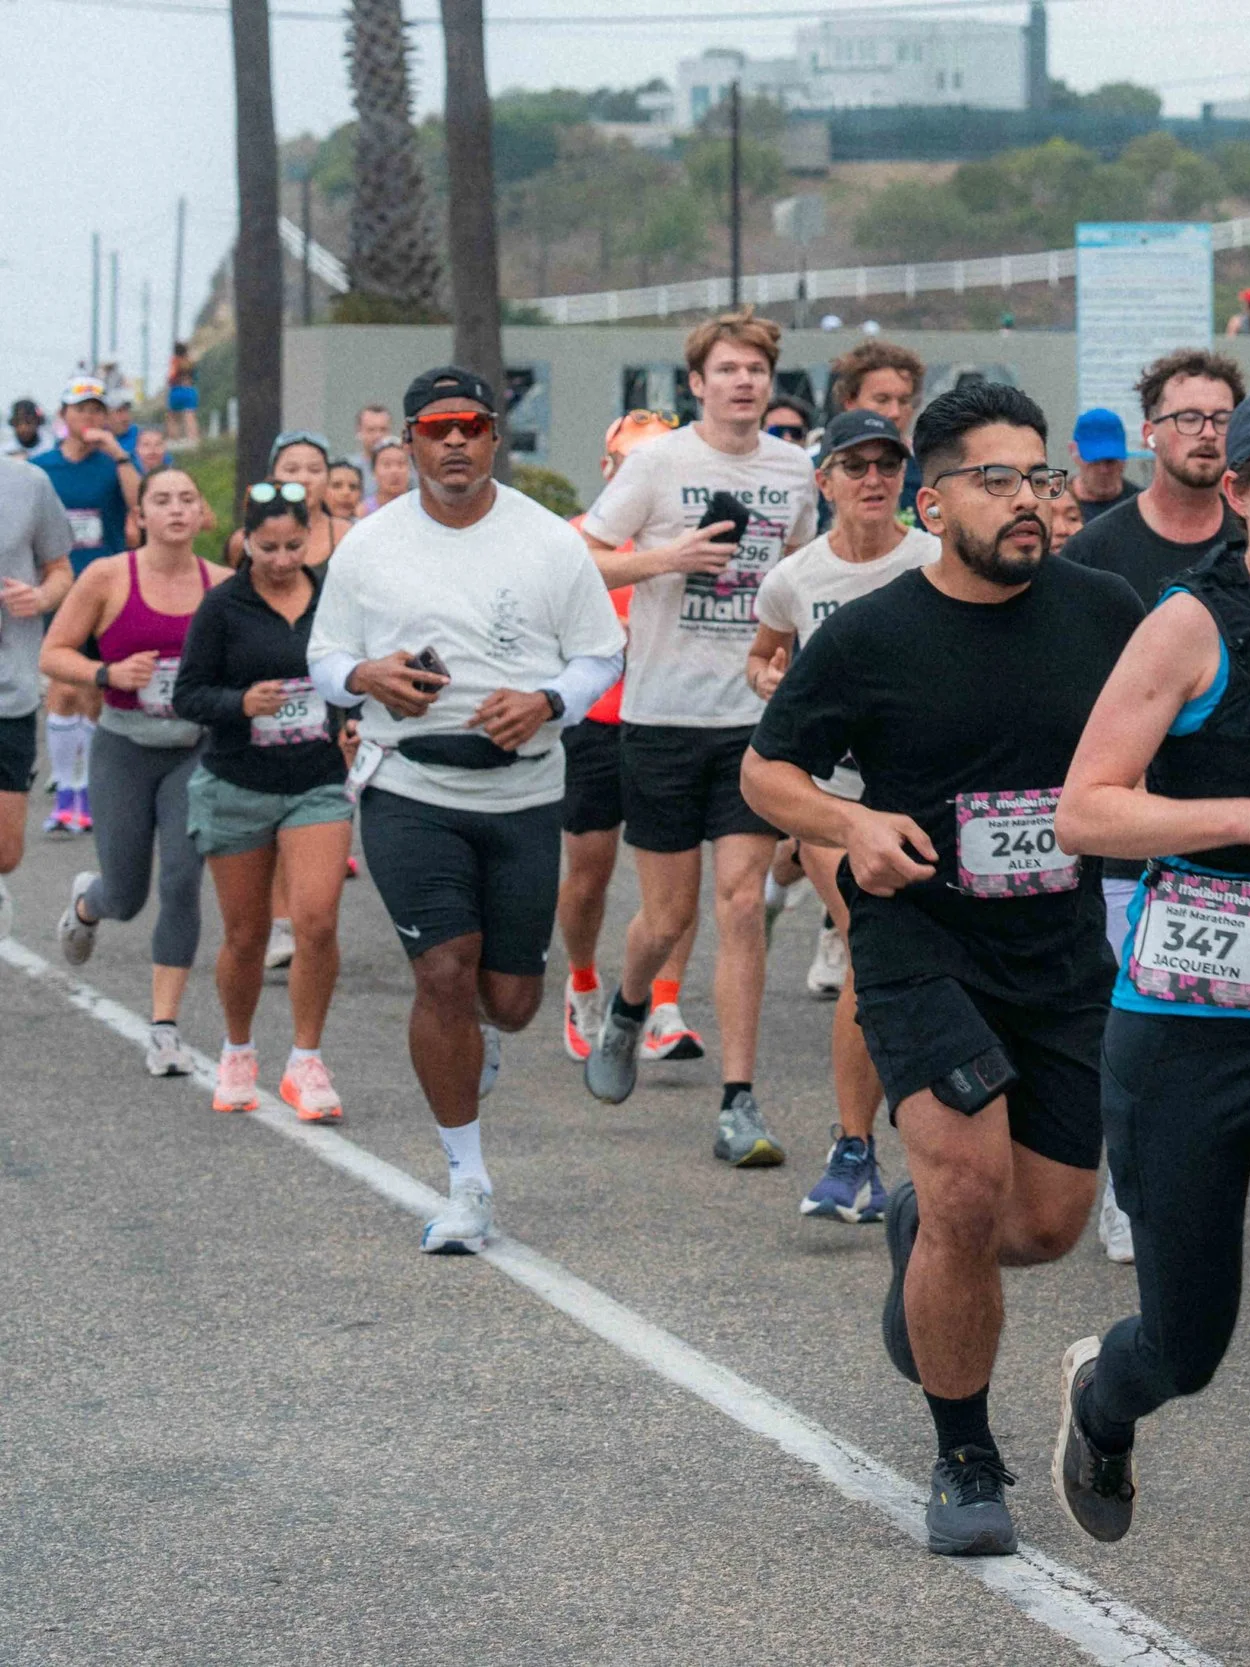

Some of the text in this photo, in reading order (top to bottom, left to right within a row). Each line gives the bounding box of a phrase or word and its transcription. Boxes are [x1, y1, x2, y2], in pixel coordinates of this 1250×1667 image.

[759, 485, 789, 504] for
[733, 545, 770, 562] 296
[682, 591, 753, 621] mali
[970, 800, 990, 810] IPS
[988, 816, 1055, 829] Half Maratho
[990, 828, 1056, 858] 240
[1007, 858, 1042, 871] ALEX
[1166, 906, 1246, 928] Half Marathon
[1162, 920, 1239, 961] 347
[1152, 953, 1241, 979] JACQUELYN
